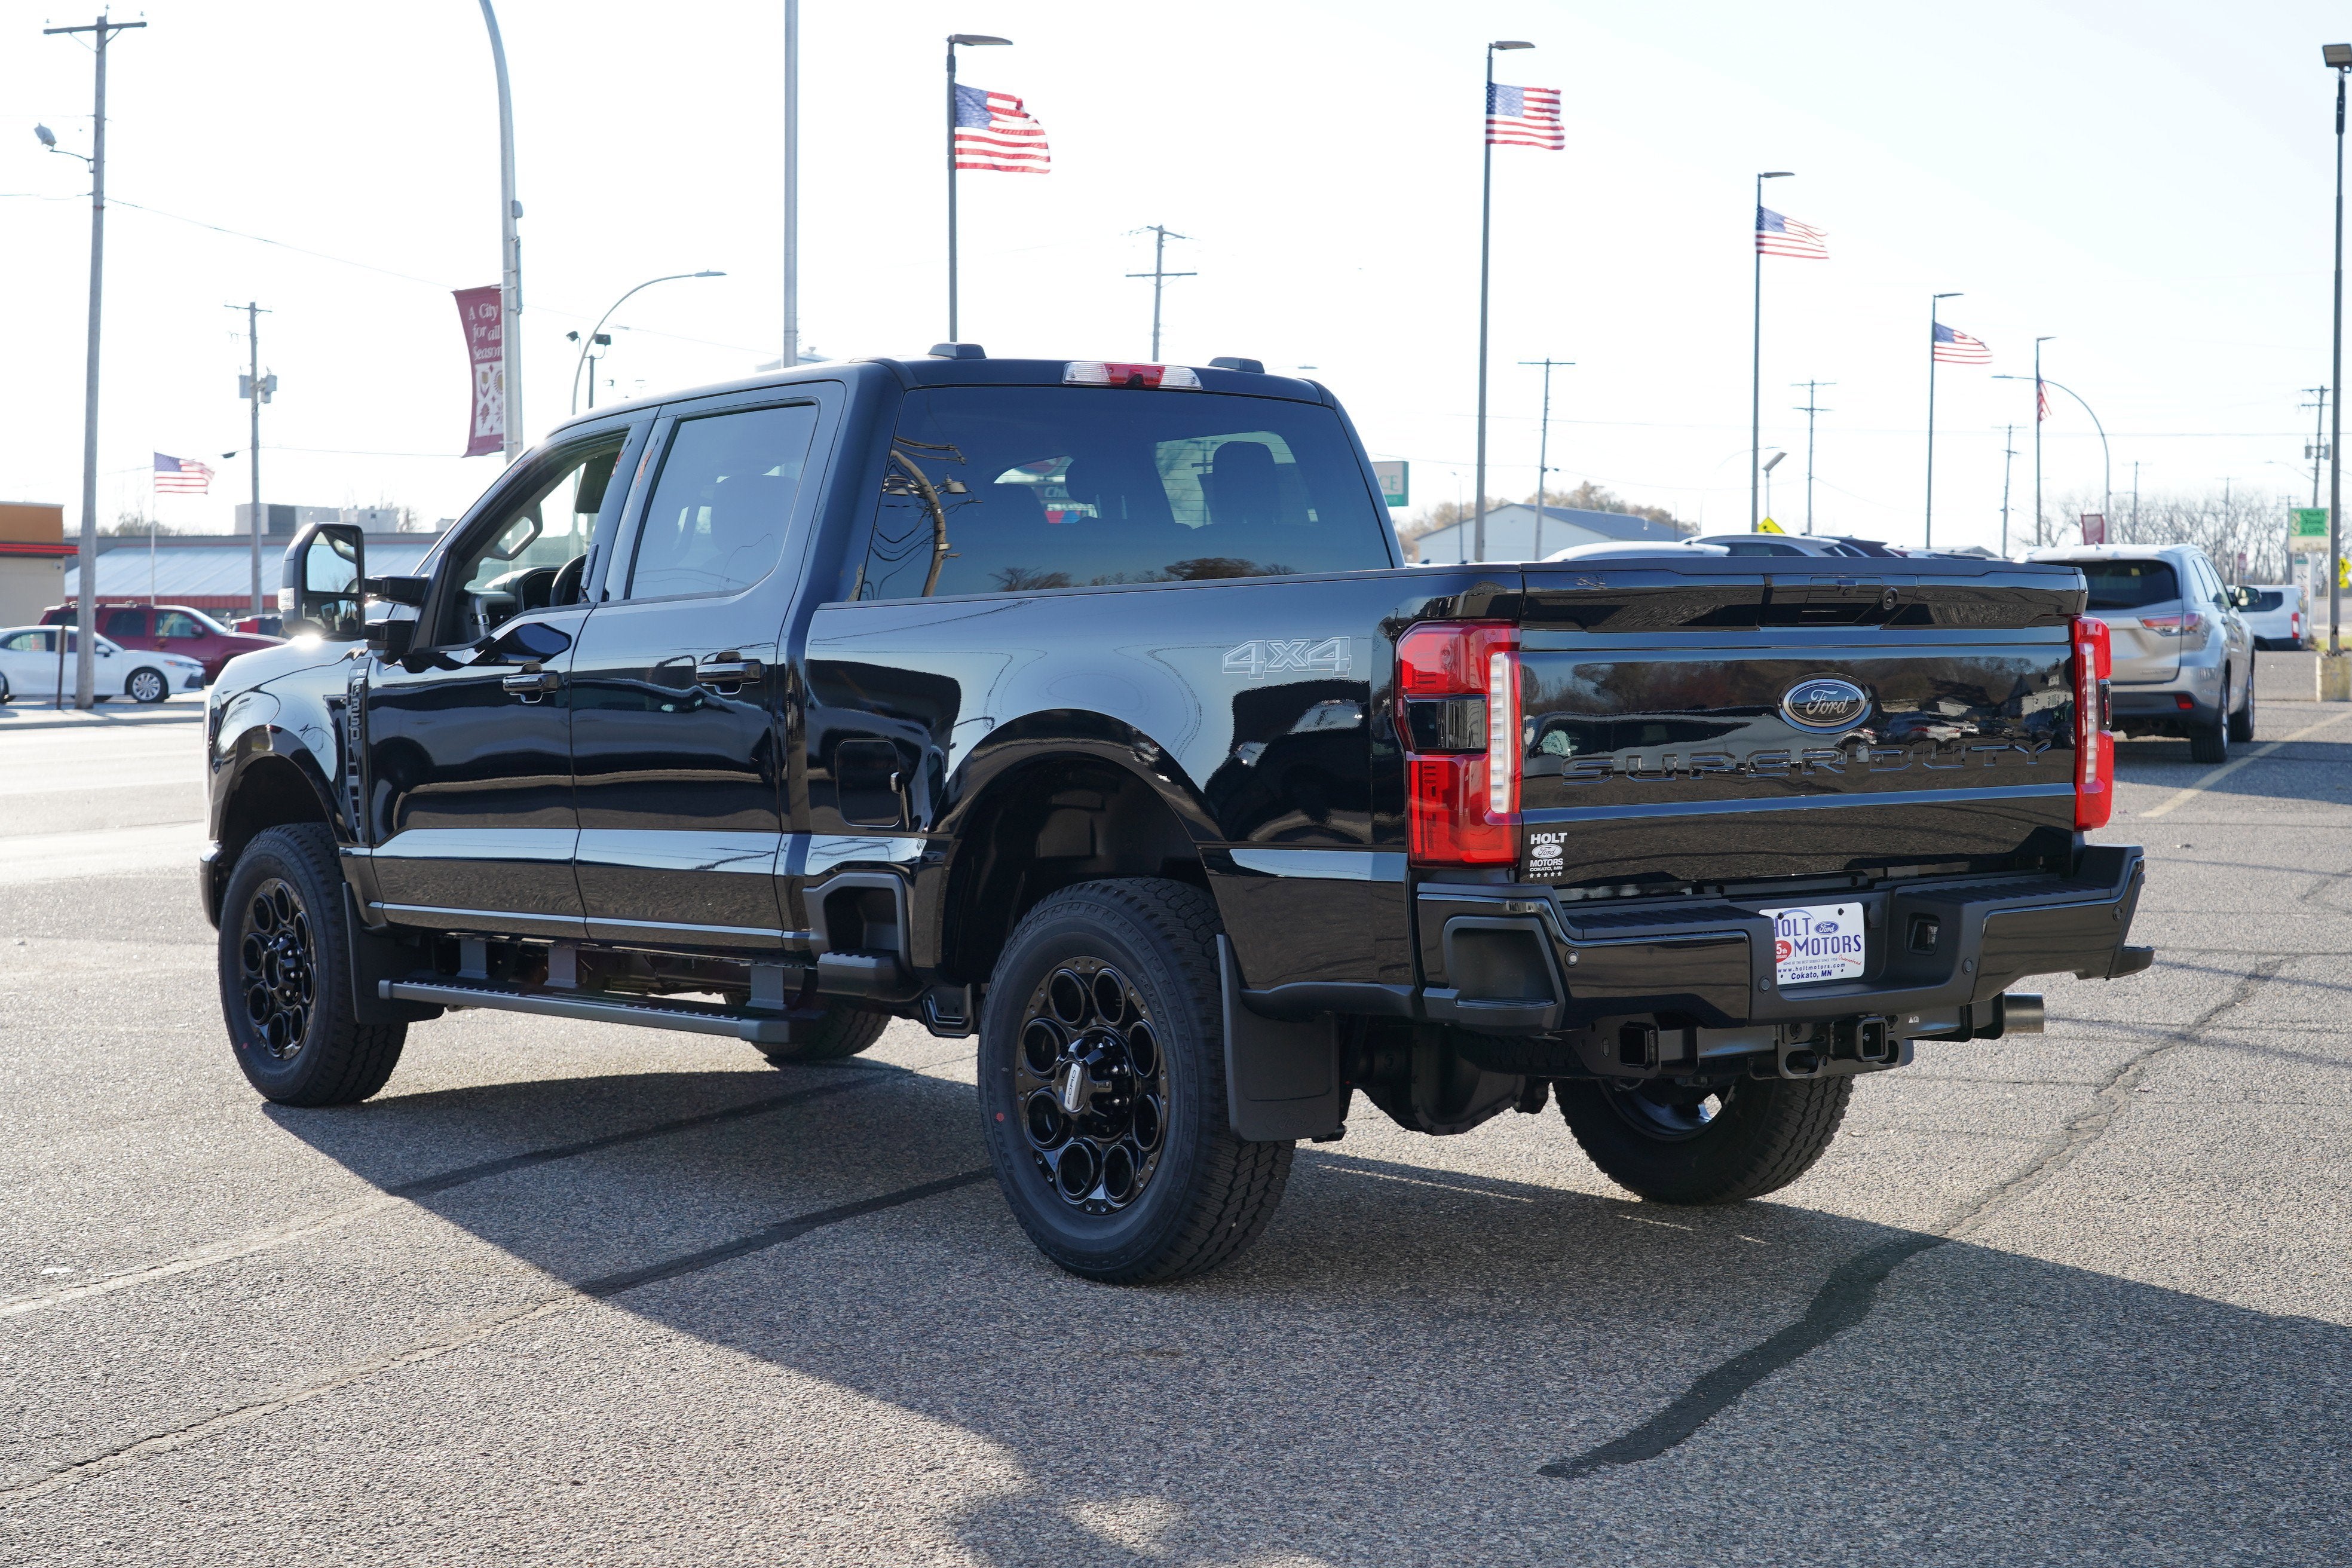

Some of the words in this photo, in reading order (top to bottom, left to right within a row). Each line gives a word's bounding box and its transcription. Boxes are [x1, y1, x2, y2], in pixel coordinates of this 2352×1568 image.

[468, 306, 476, 320] A
[479, 303, 499, 321] City
[472, 323, 487, 343] for
[488, 324, 501, 341] all
[473, 345, 502, 361] Season
[1806, 688, 1849, 715] Ford
[1562, 746, 1848, 786] SUPER
[1869, 739, 2052, 772] DUTY
[1530, 832, 1567, 844] HOLT
[1538, 846, 1555, 856] Ford
[1530, 858, 1563, 867] MOTORS
[1819, 923, 1835, 933] Ford
[1794, 935, 1861, 957] MOTORS
[1778, 963, 1845, 973] www.holtmotors.com
[1067, 1070, 1076, 1105] FORD
